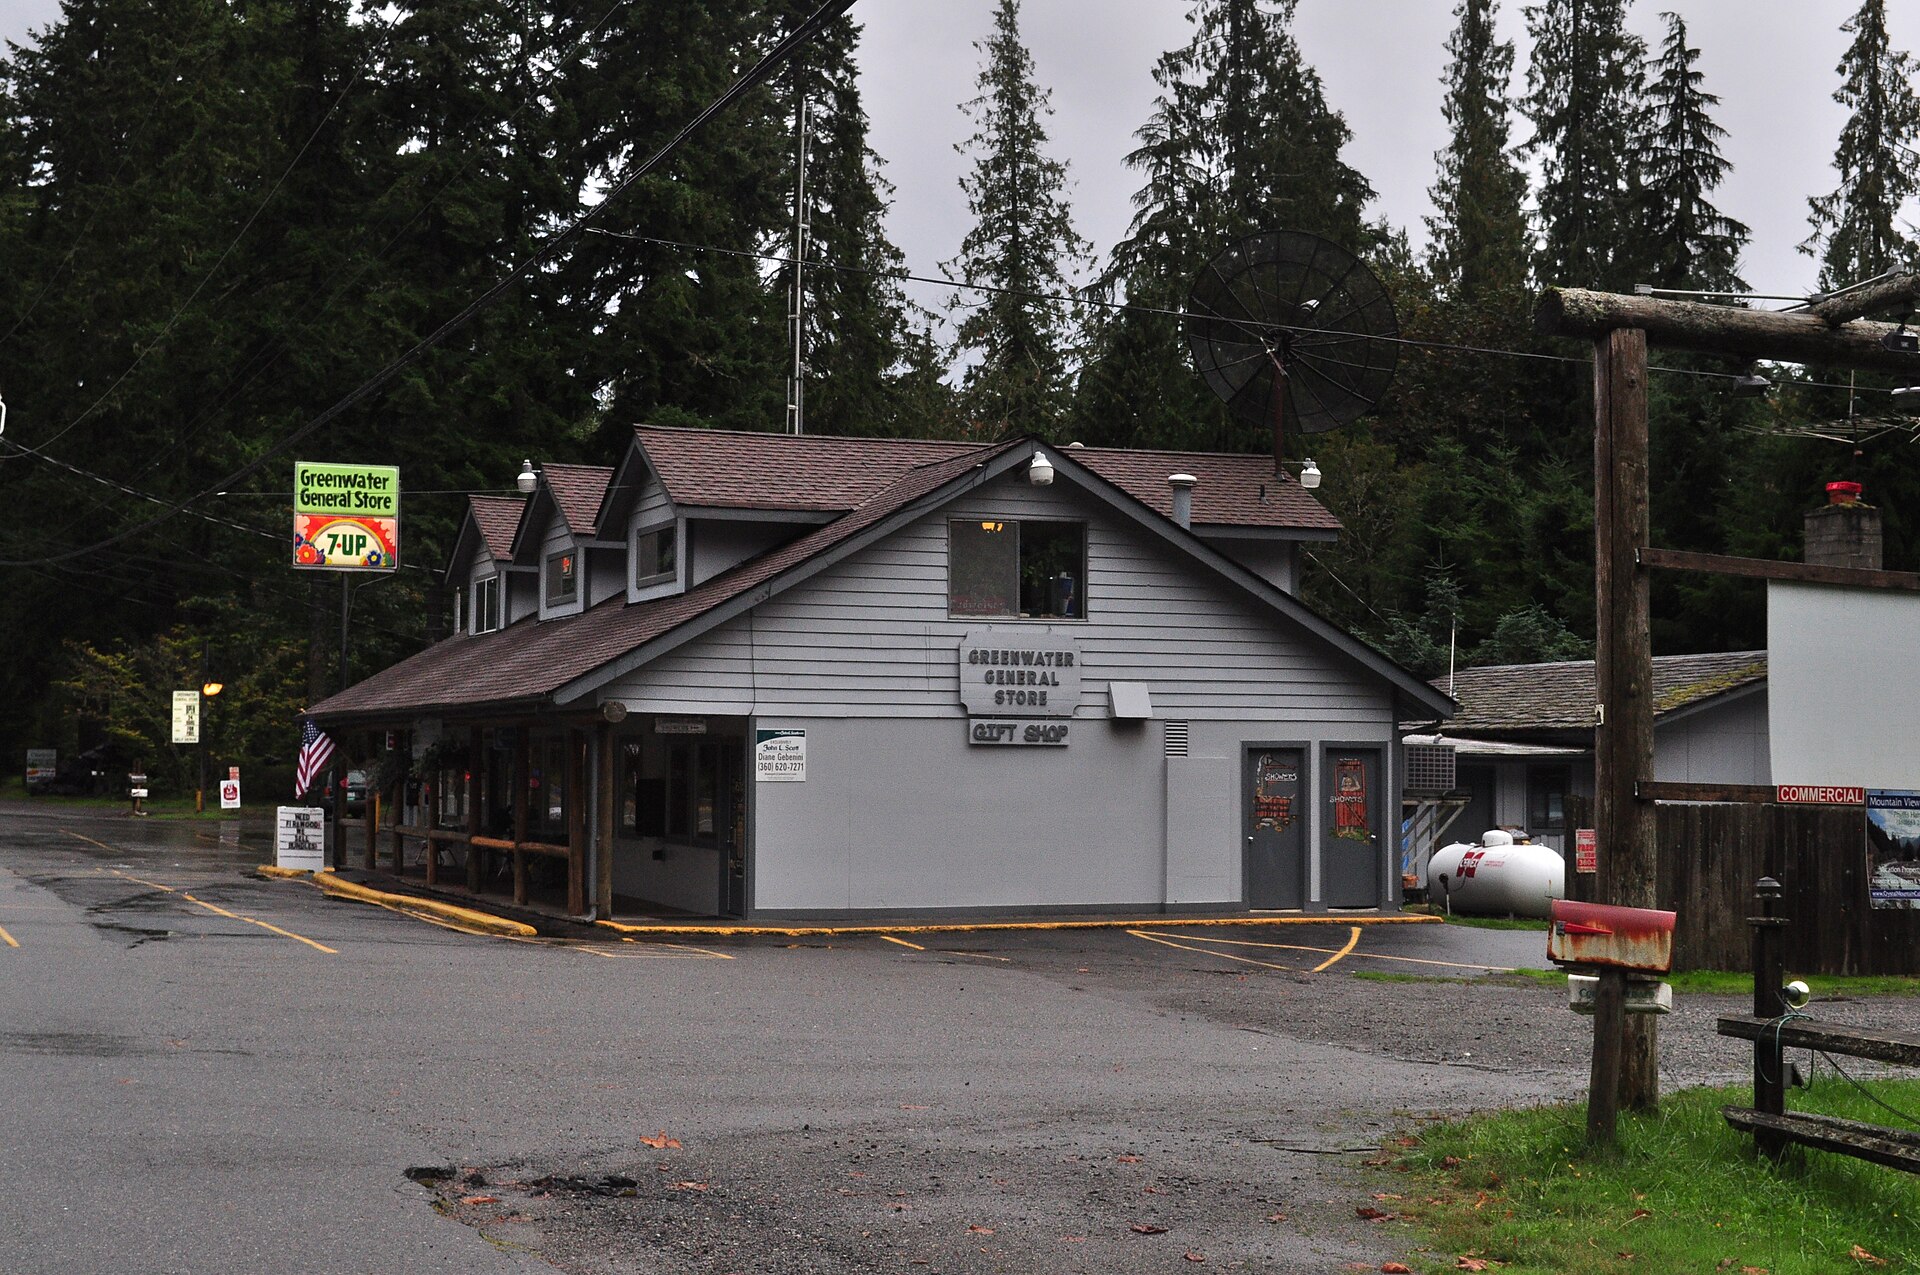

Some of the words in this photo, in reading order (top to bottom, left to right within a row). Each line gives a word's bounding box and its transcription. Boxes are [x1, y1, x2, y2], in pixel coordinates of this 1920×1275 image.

[301, 469, 389, 490] Greenwater
[300, 488, 351, 507] General
[354, 491, 392, 510] Store
[968, 649, 1074, 667] GREENWATER
[984, 669, 1060, 687] GENERAL
[995, 689, 1048, 706] STORE
[973, 723, 1017, 742] GIFT
[1024, 724, 1069, 743] SHOP
[758, 753, 776, 761] Diane
[758, 762, 774, 772] (360)
[1780, 787, 1863, 803] COMMERCIAL
[1869, 797, 1902, 806] Mountain
